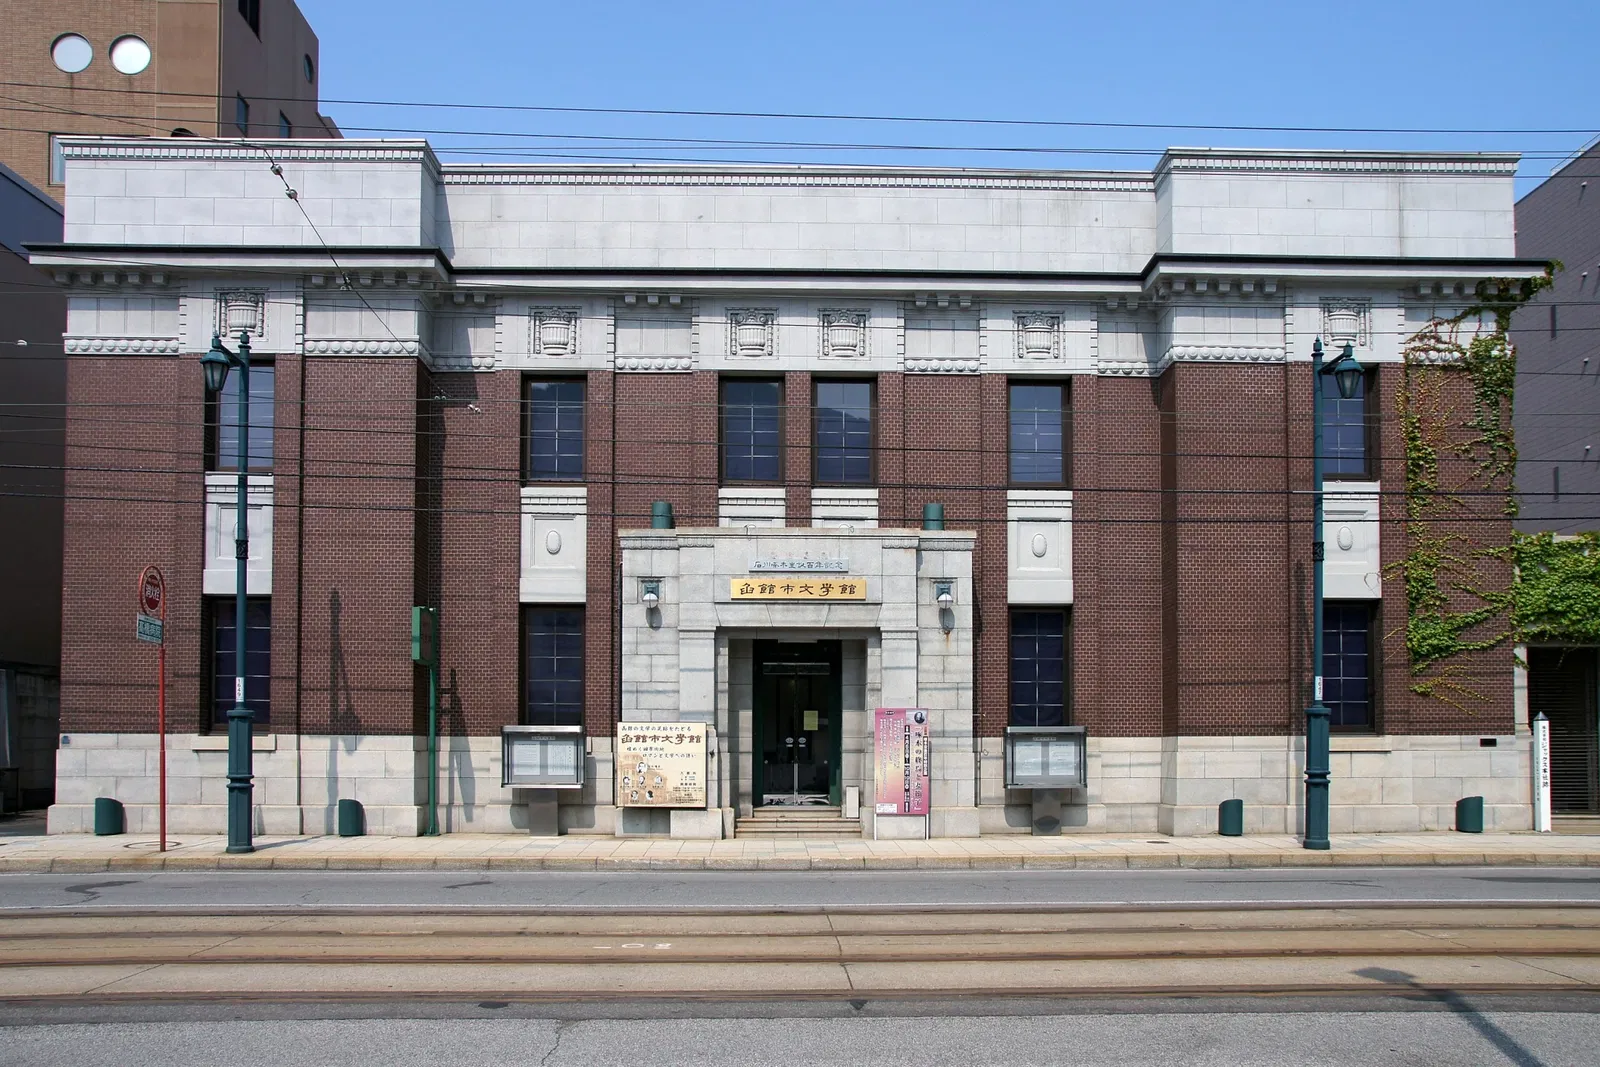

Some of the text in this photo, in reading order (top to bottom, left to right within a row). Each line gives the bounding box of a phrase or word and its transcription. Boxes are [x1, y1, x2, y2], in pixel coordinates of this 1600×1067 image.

[740, 582, 857, 597] 函館市文学館
[621, 733, 702, 745] 函館市文学館
